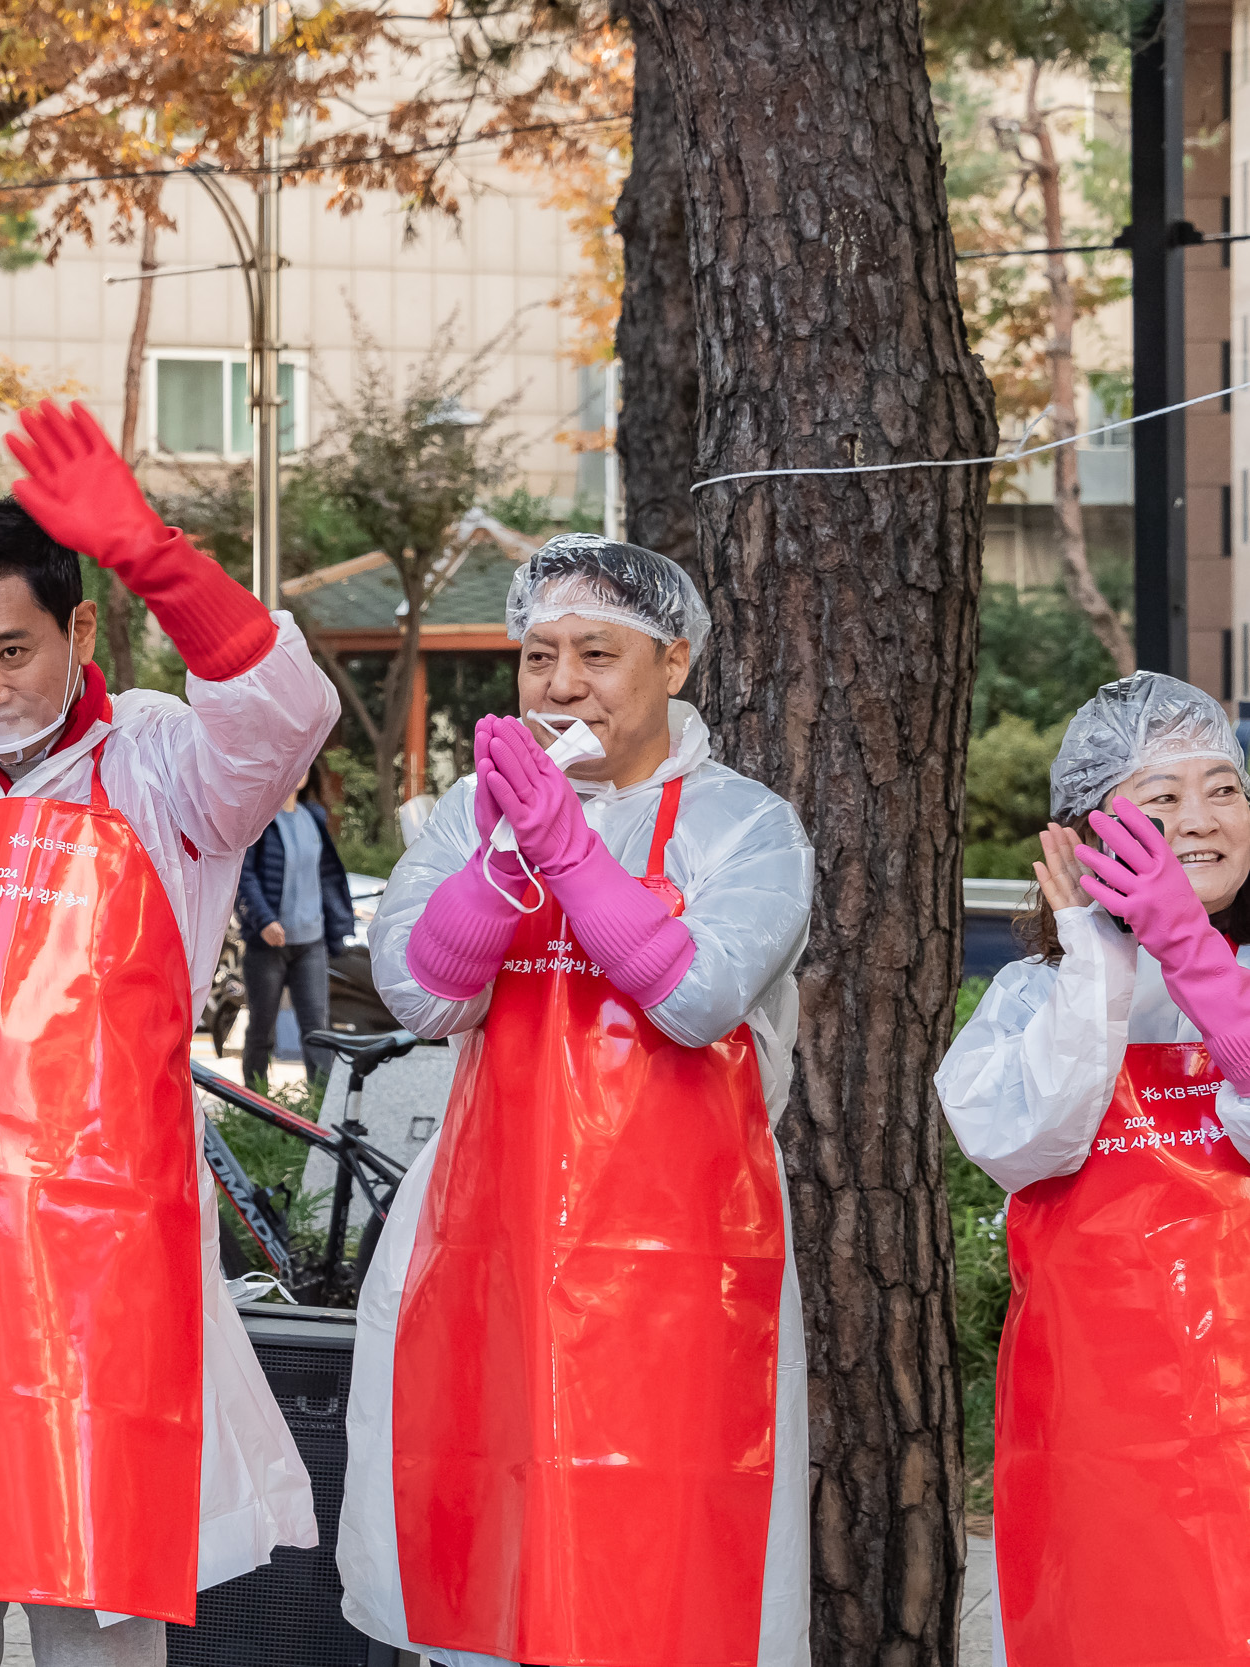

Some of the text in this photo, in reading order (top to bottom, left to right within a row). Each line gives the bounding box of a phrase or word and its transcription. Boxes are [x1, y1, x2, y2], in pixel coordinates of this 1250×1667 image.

[546, 940, 573, 952] 2024
[502, 958, 533, 974] 제2회
[547, 956, 587, 975] 사랑의
[1124, 1115, 1156, 1130] 2024
[1096, 1136, 1129, 1155] 광진
[1130, 1131, 1176, 1149] 사랑의
